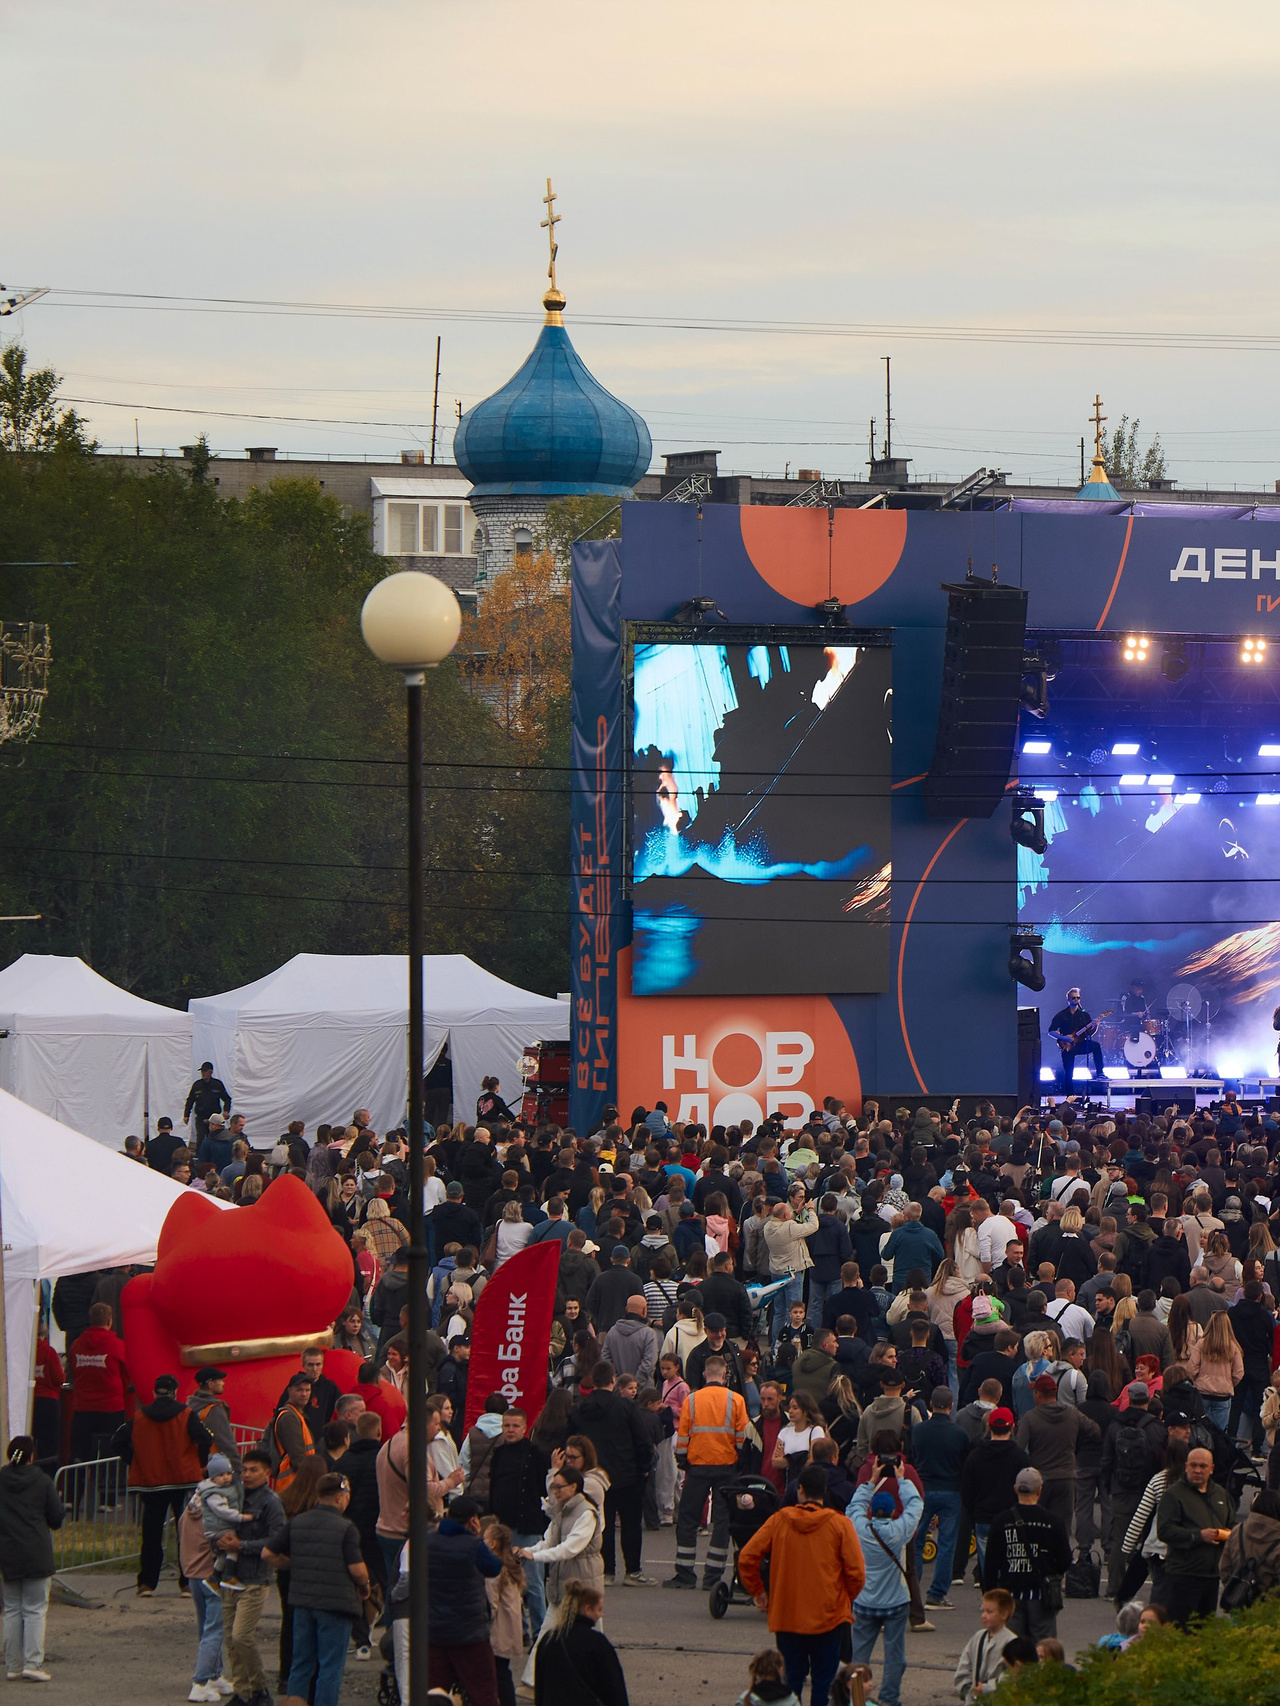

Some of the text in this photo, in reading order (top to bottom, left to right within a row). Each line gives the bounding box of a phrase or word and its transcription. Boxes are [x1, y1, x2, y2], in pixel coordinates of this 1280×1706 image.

[577, 822, 595, 1089] ВСЁ БУДЕТ
[662, 1031, 815, 1090] НОВ
[497, 1292, 528, 1361] Банк
[1005, 1528, 1019, 1543] НА
[1006, 1543, 1038, 1557] СЕВЕЕ
